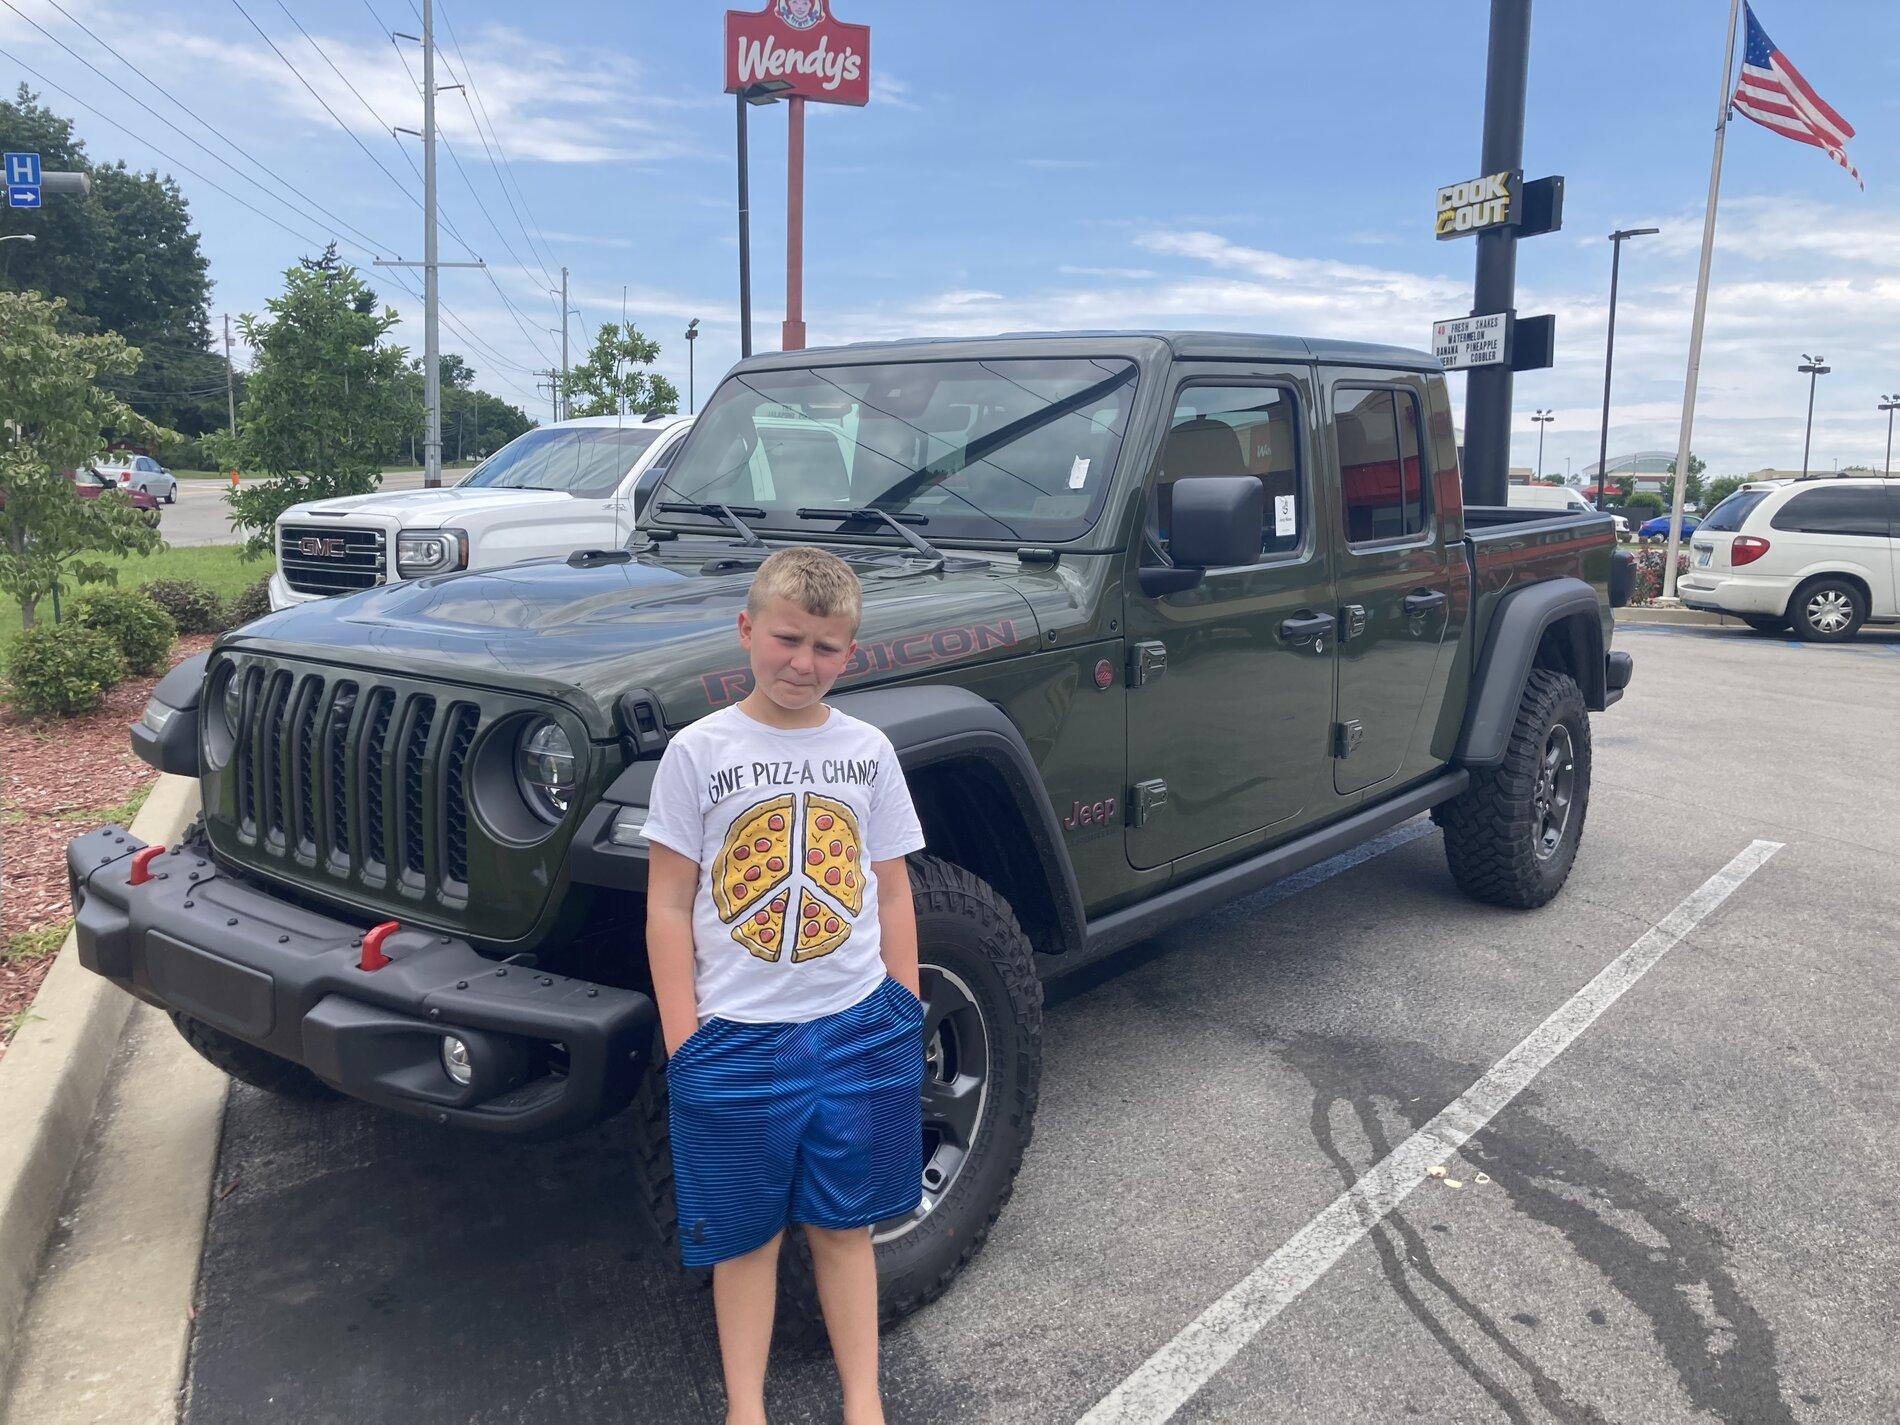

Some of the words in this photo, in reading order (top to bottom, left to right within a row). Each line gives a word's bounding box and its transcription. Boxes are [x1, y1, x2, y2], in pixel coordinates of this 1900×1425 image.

[738, 35, 861, 90] Wendy's
[12, 156, 34, 183] H
[1437, 172, 1510, 212] COOK
[1455, 197, 1510, 231] OUT
[1447, 330, 1485, 345] WATERMELON
[1451, 322, 1469, 333] FRESH
[1475, 317, 1498, 330] SHAKES
[1436, 345, 1459, 357] BANANA
[1465, 340, 1498, 353] PINEAPPLE
[1470, 351, 1497, 363] COBBLER
[300, 537, 345, 557] GMC
[708, 765, 745, 804] GIVE
[752, 759, 815, 786] PIZZ-A
[1063, 798, 1116, 831] Jeep
